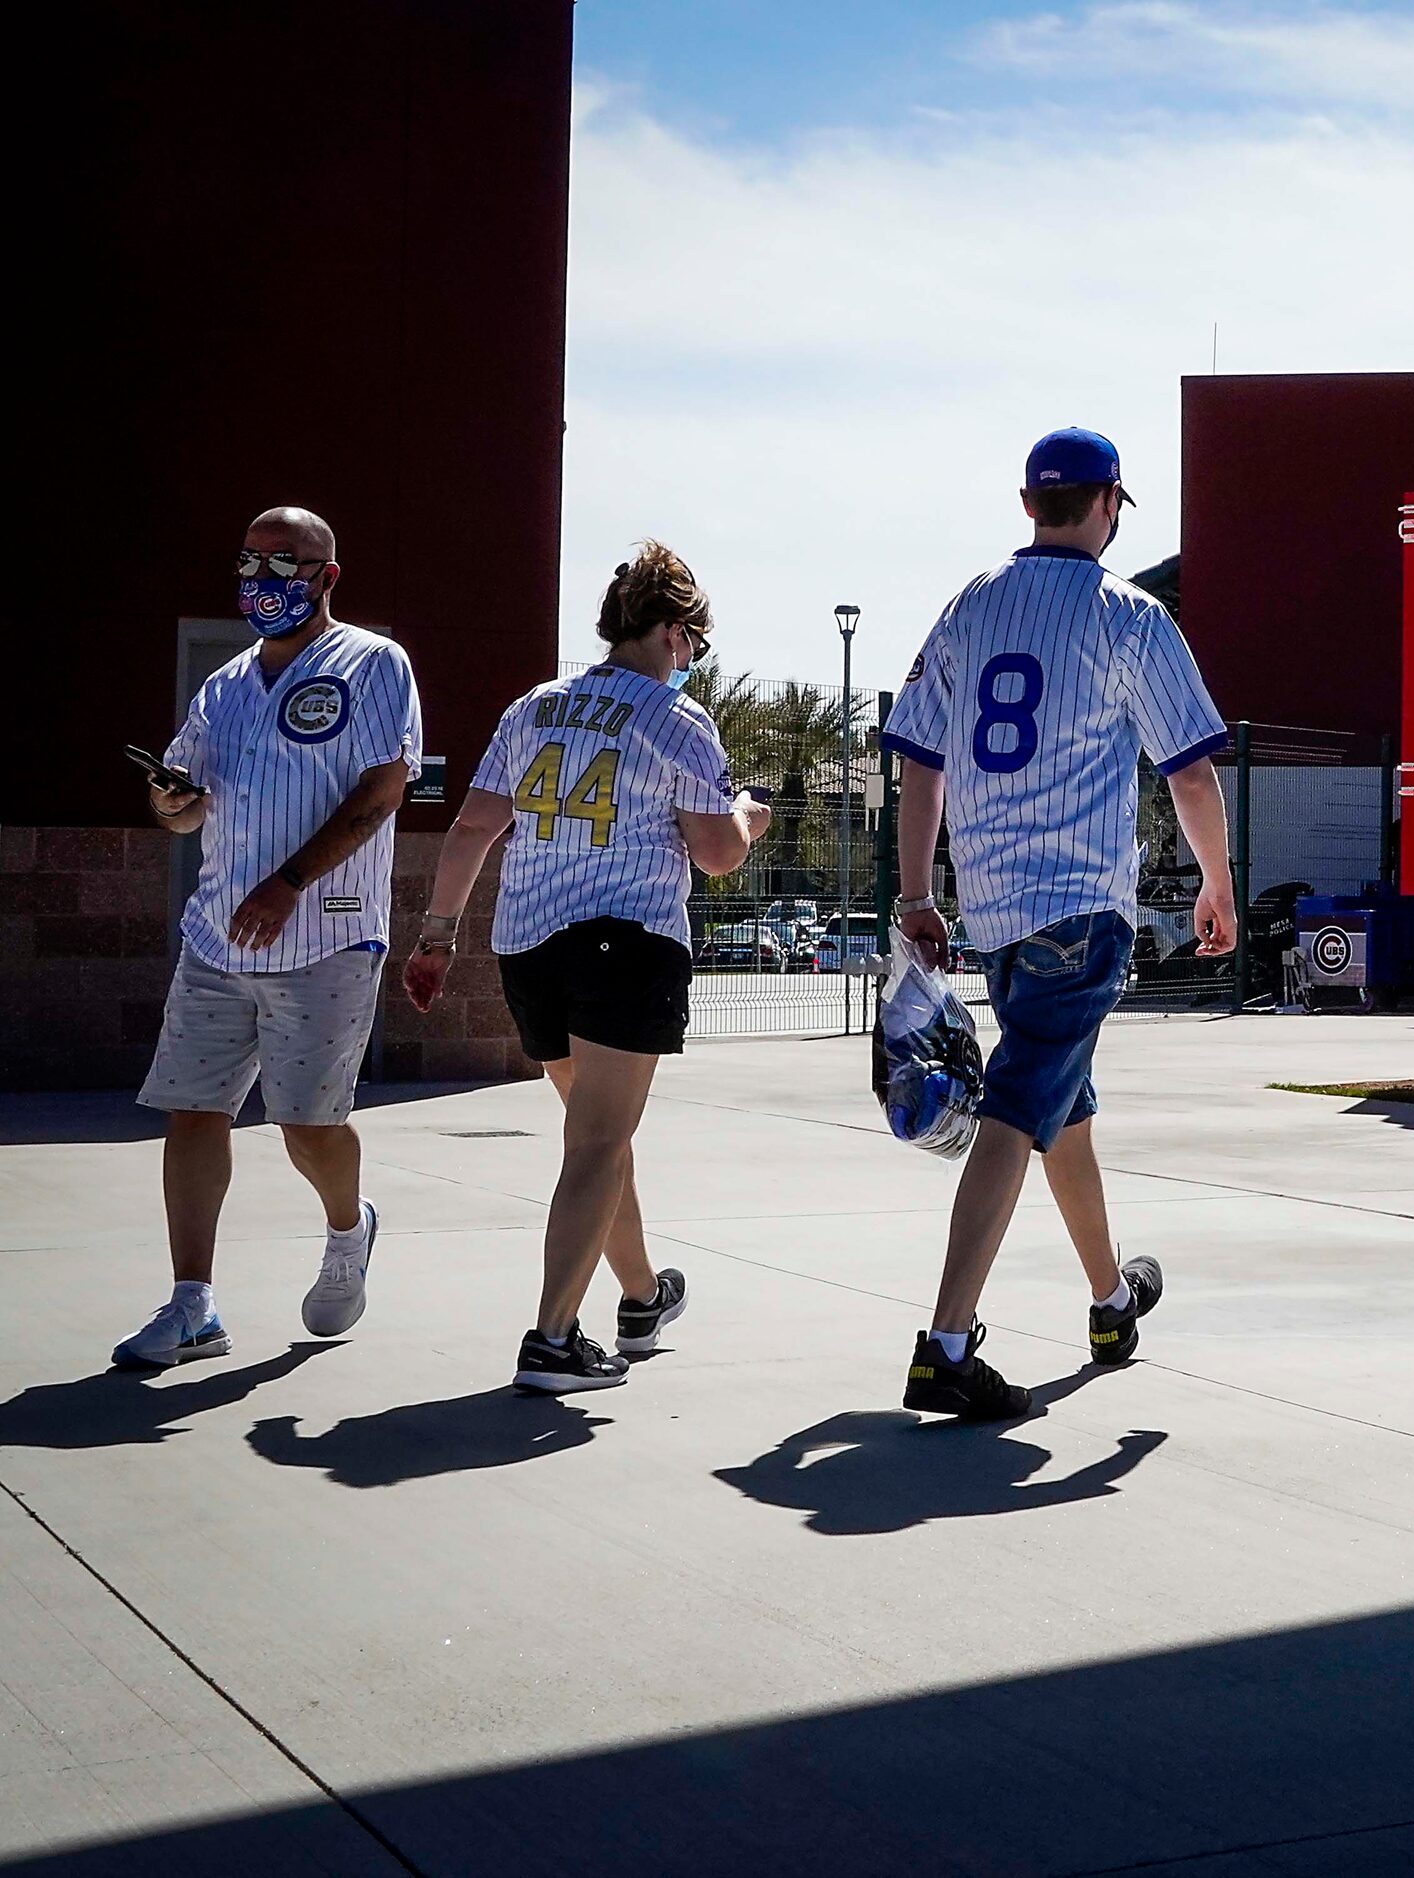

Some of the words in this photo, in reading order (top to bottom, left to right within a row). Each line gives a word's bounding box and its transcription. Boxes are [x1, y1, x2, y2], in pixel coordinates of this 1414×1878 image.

[535, 693, 635, 738] RIZZO
[972, 652, 1045, 774] 8
[515, 741, 622, 848] 44
